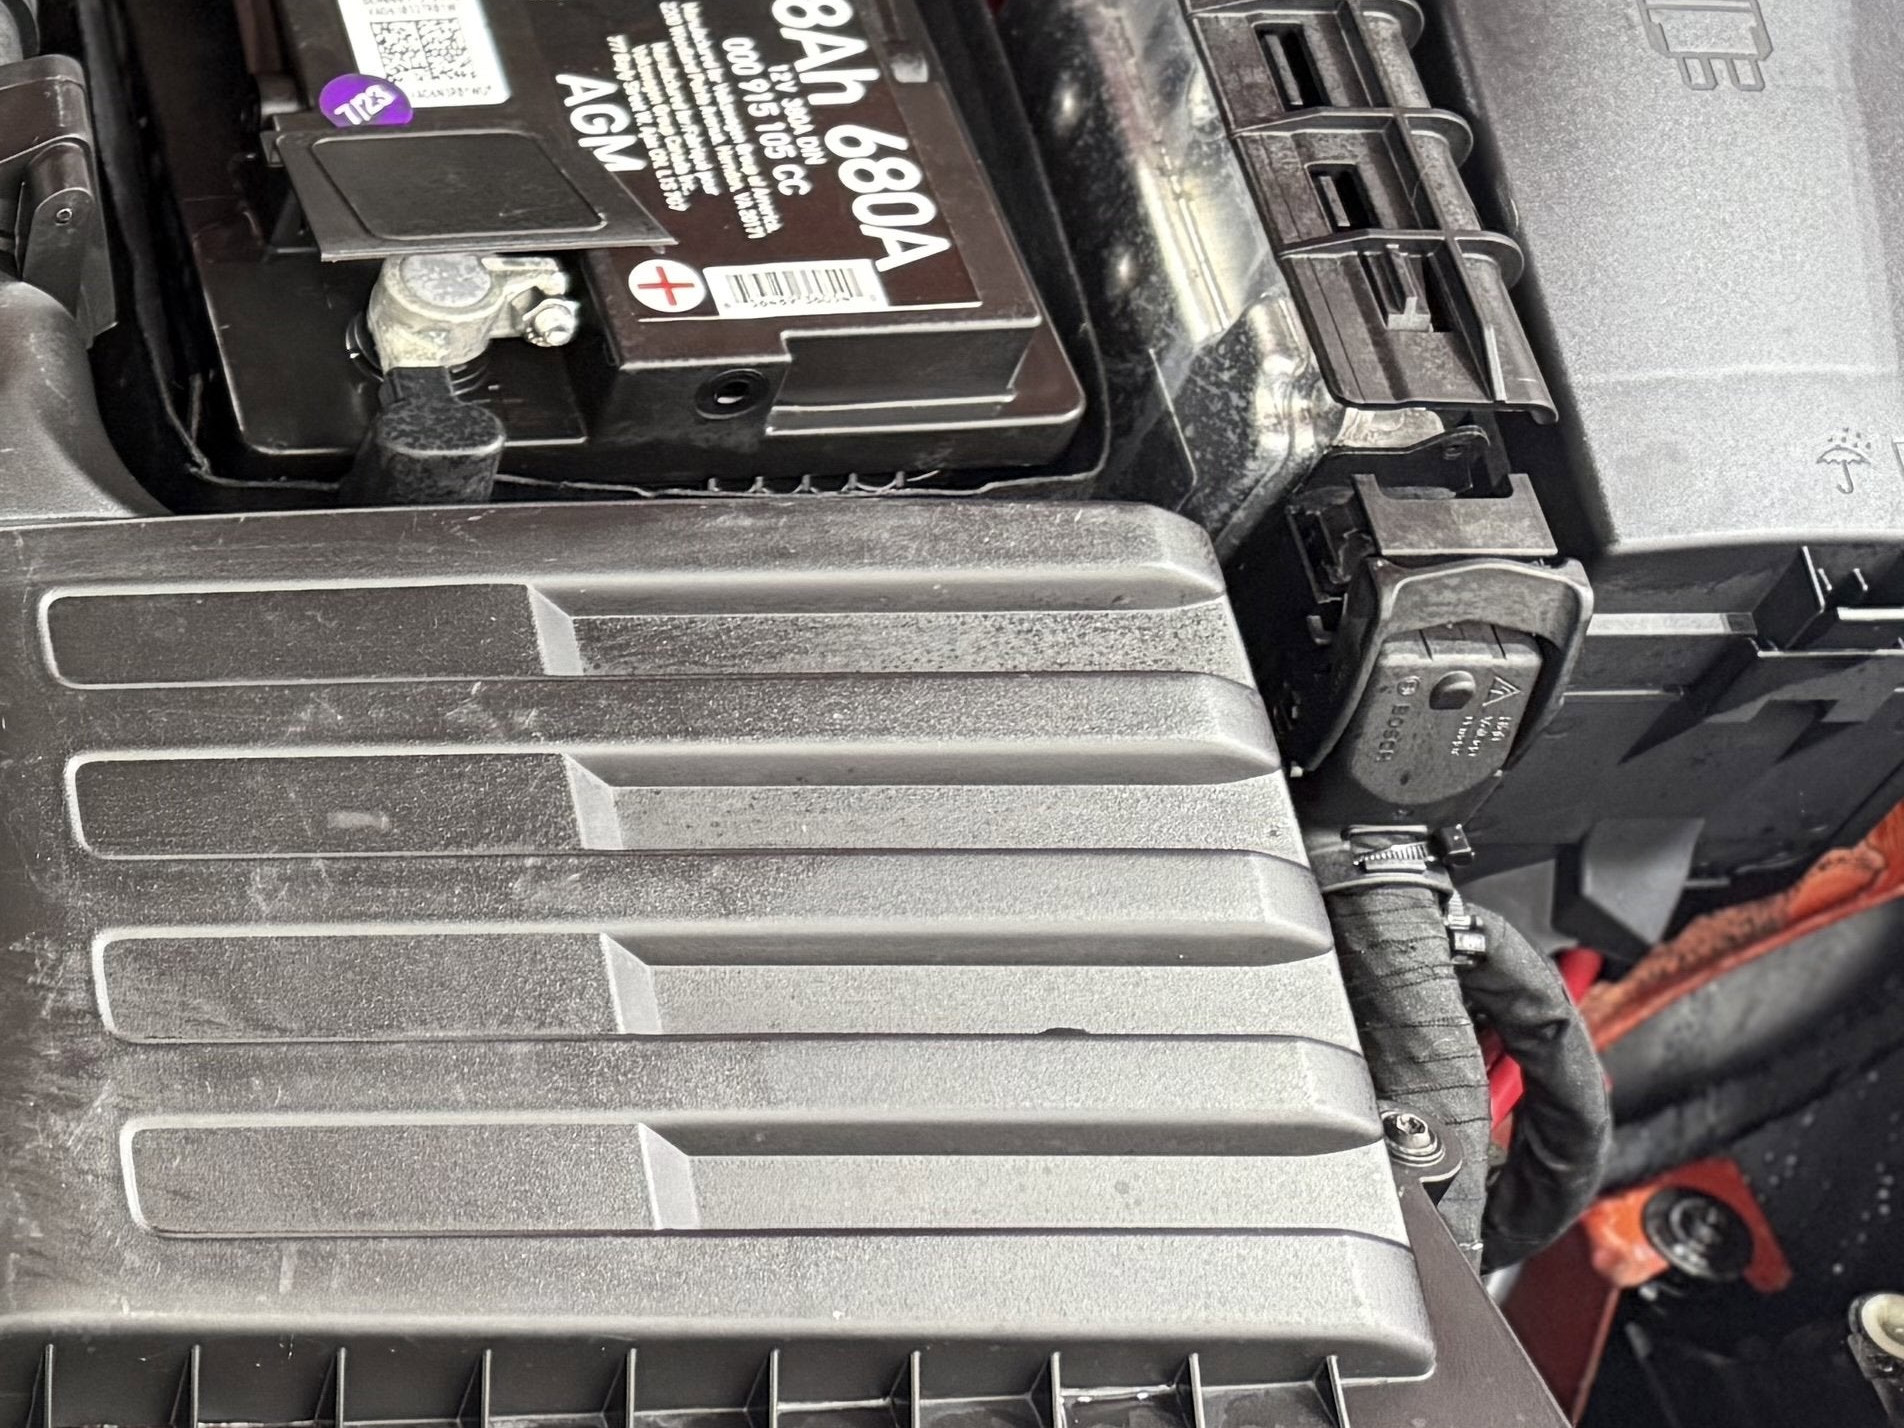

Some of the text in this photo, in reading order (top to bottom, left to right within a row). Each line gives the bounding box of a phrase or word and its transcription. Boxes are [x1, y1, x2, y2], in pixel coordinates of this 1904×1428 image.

[556, 74, 648, 172] AGM
[722, 37, 813, 196] 000 915 105 CC
[768, 64, 799, 93] 12V
[796, 136, 828, 166] DIN
[825, 124, 951, 272] 680A
